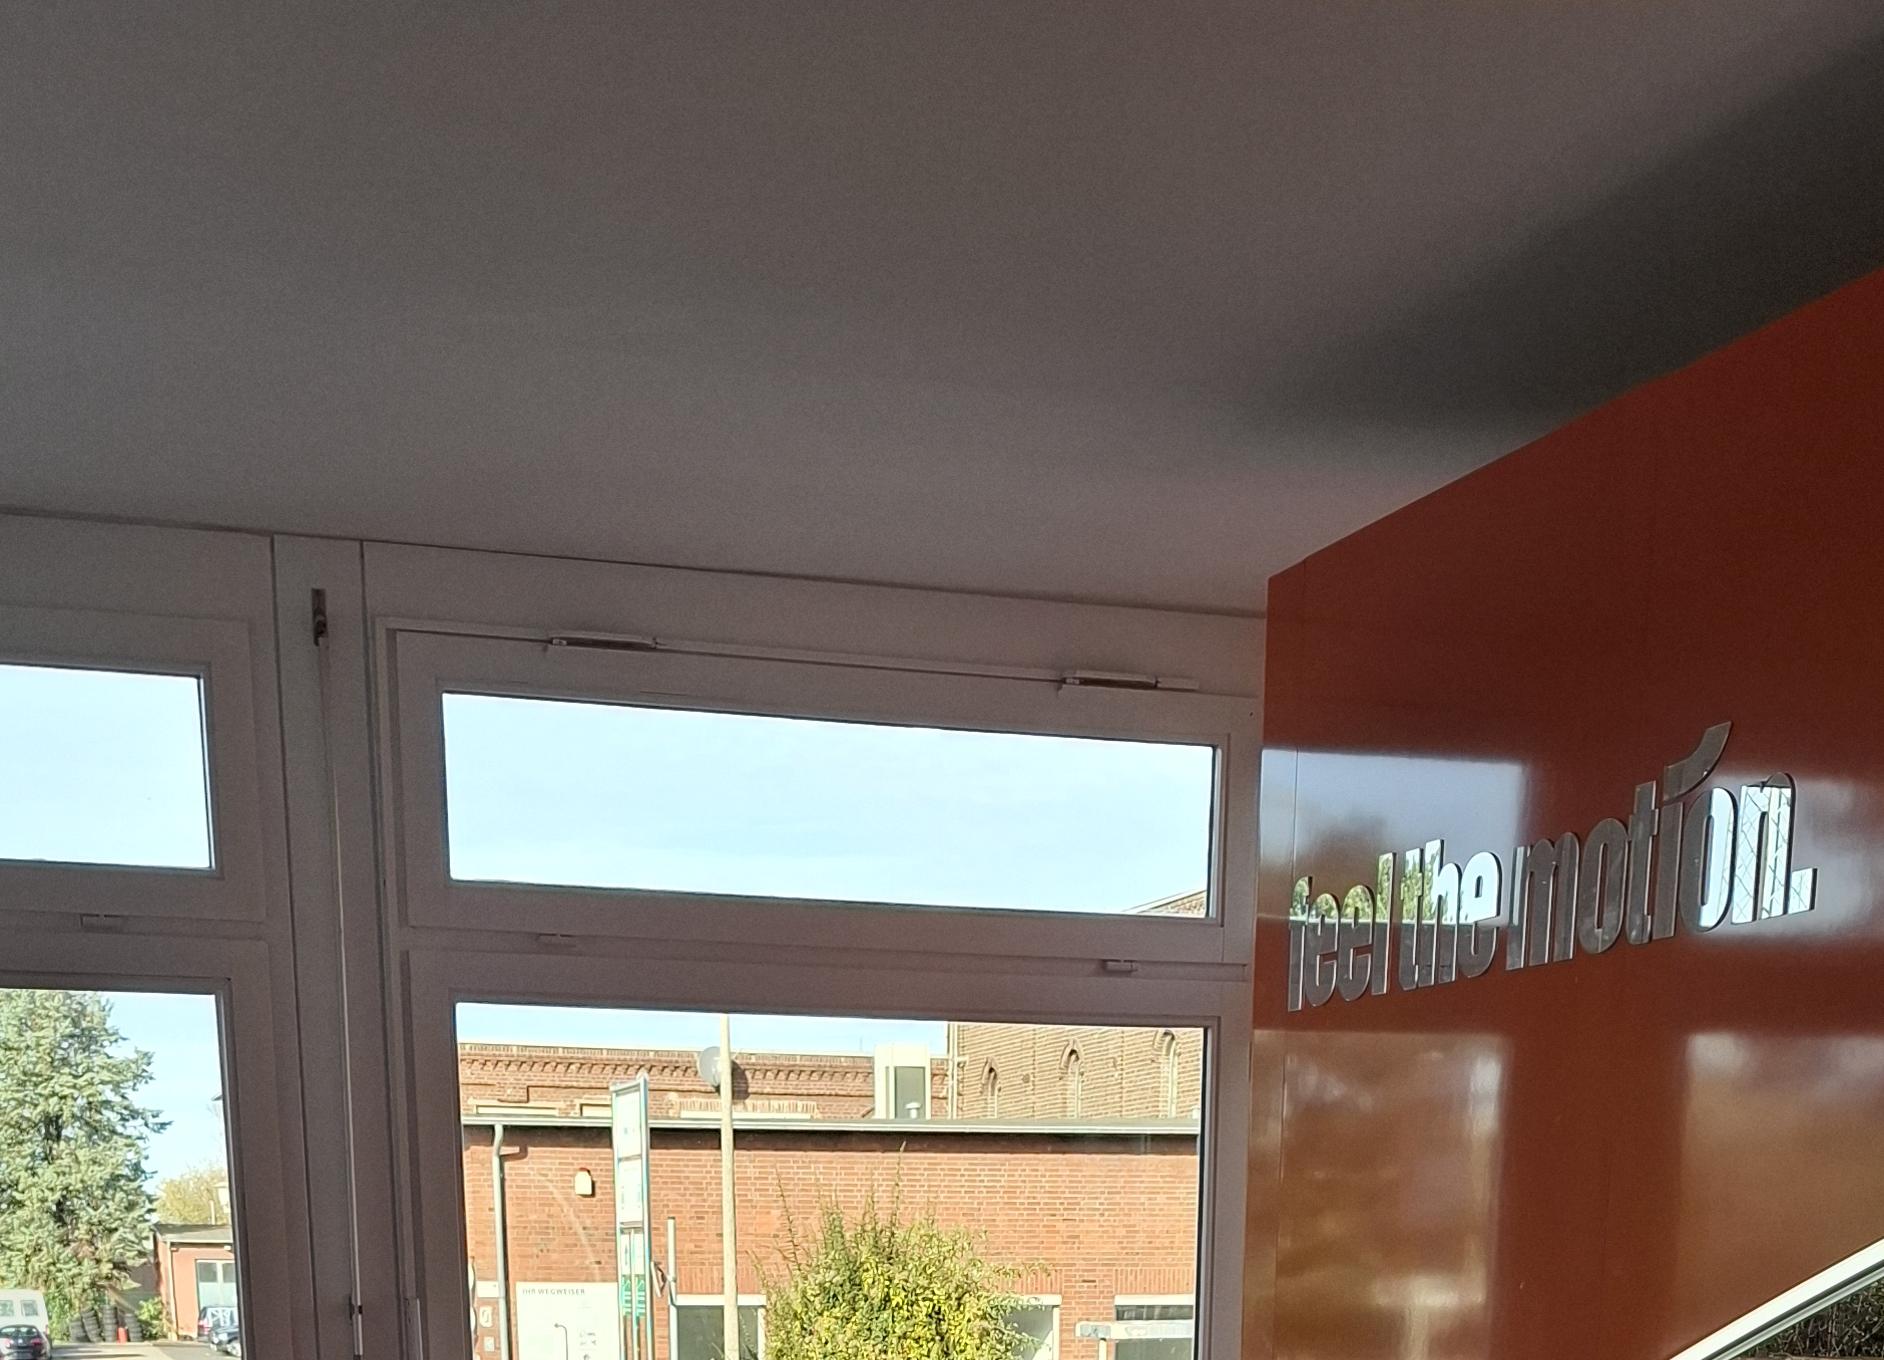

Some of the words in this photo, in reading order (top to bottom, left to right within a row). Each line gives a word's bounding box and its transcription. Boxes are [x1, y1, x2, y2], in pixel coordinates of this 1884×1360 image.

[1288, 851, 1397, 1012] feel
[1399, 838, 1501, 991] the
[1505, 720, 1818, 971] motion.
